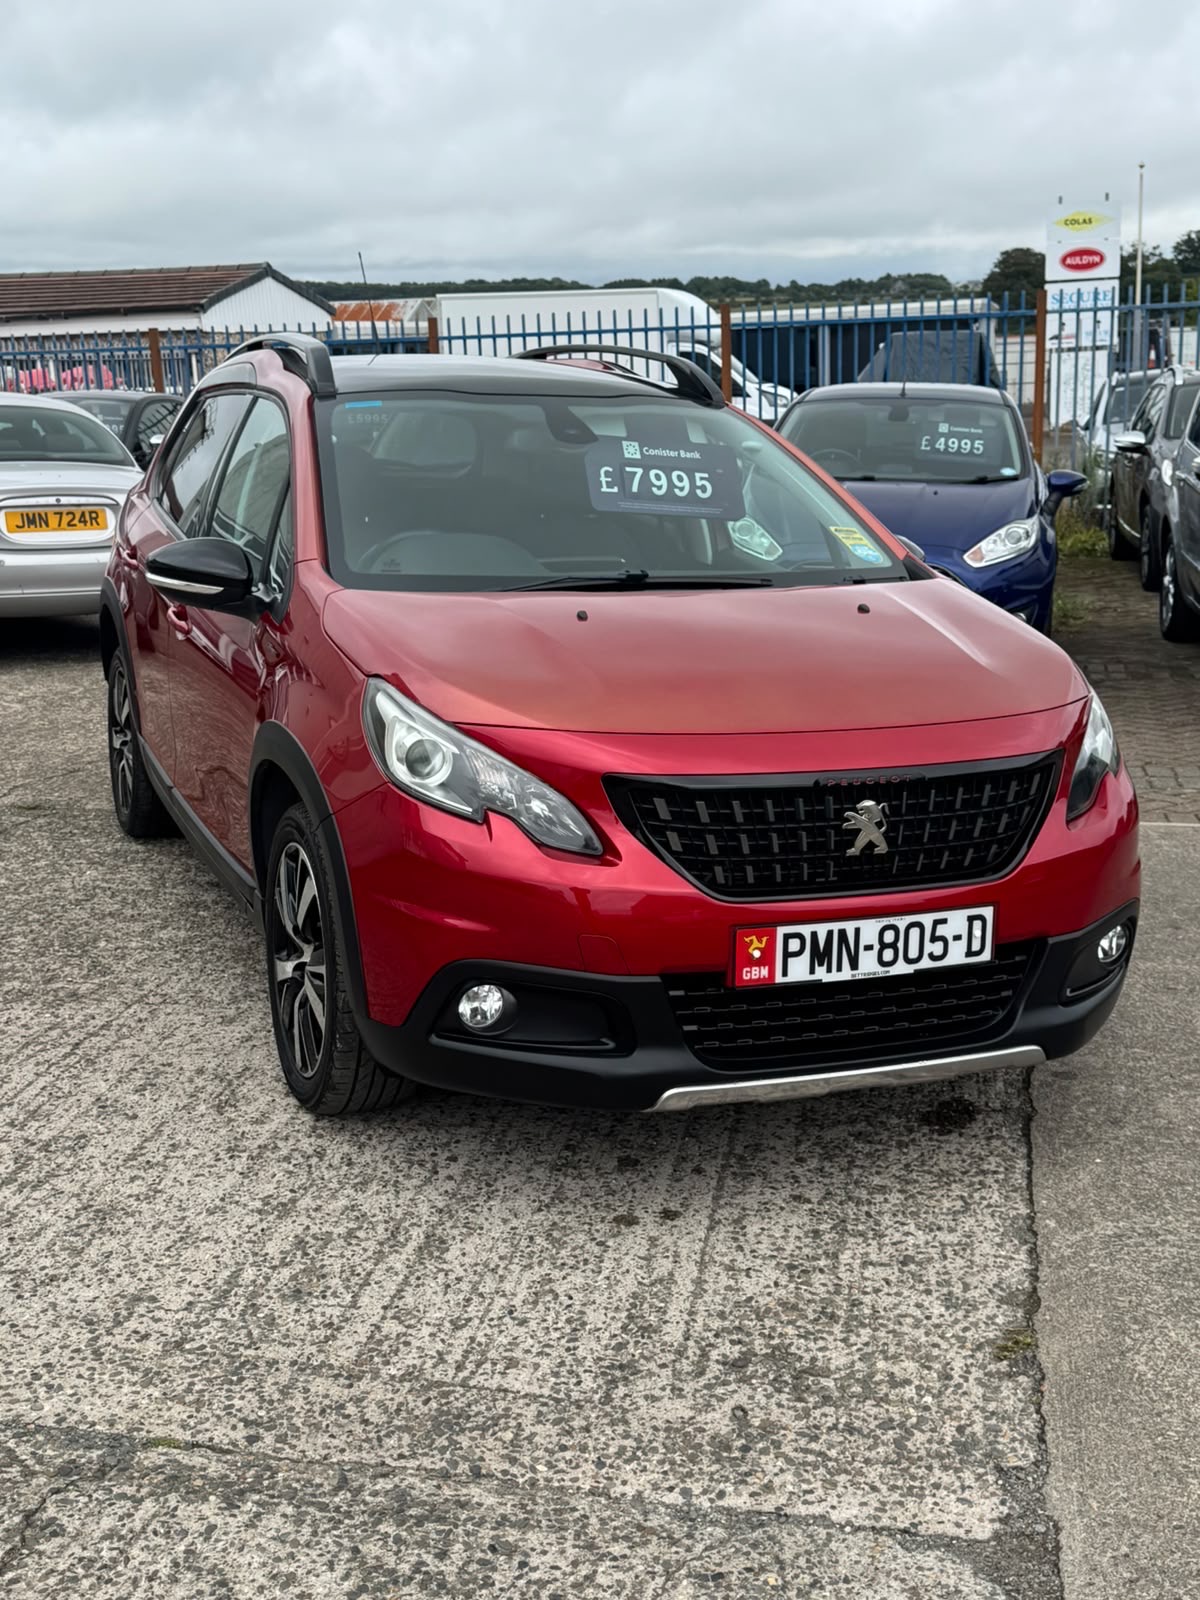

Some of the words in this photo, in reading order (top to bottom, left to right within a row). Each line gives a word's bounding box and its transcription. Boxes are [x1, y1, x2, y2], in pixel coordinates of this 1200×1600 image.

[1063, 217, 1093, 226] COLAS
[1065, 254, 1101, 266] AULDYN
[642, 446, 679, 458] Conister
[680, 449, 702, 459] Bank
[15, 512, 50, 529] JMN
[53, 510, 100, 528] 724R
[826, 774, 913, 787] PEUGEOT
[781, 913, 988, 978] PMN-805-D
[742, 965, 769, 980] GBM
